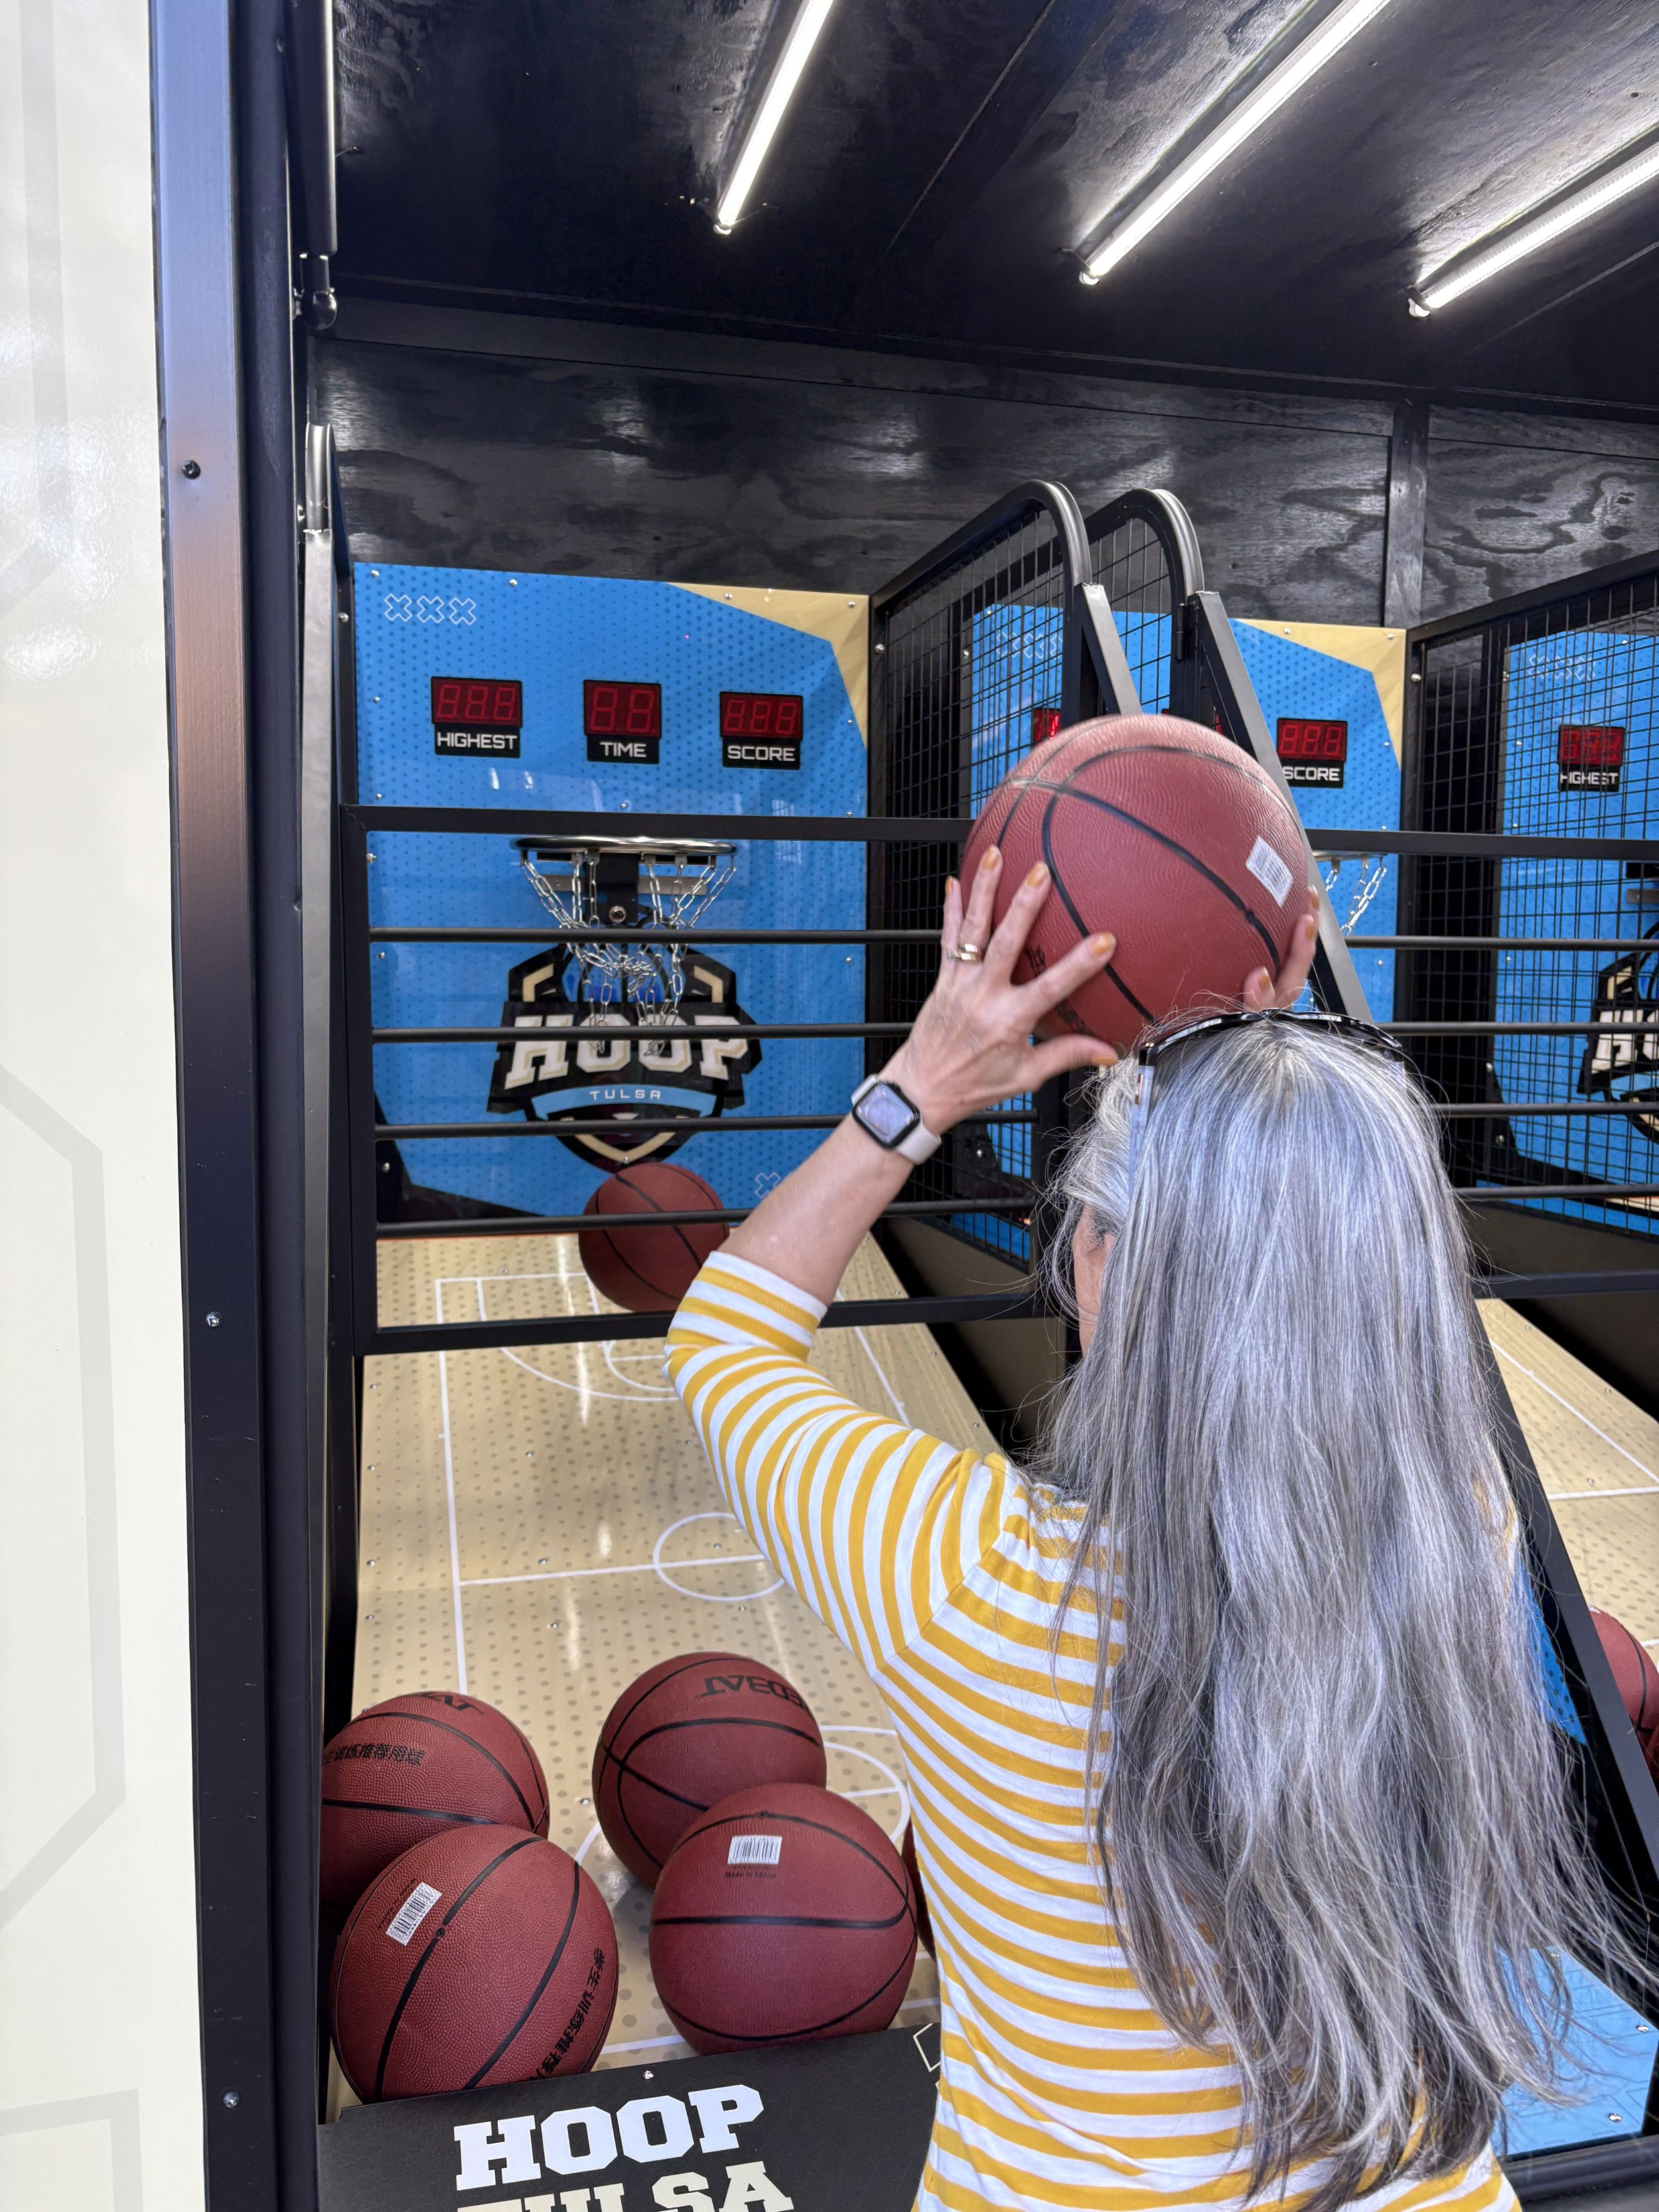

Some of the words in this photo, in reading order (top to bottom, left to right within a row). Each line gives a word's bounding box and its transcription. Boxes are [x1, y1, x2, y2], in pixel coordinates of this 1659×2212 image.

[437, 731, 518, 750] HIGHEST
[599, 741, 647, 758] TIME
[727, 745, 796, 762] SCORE
[1282, 766, 1340, 782] SCORE
[1559, 771, 1619, 785] HIGHEST
[504, 1013, 749, 1090] HOOP
[589, 1089, 661, 1100] TULSA
[453, 2084, 764, 2191] HOOP
